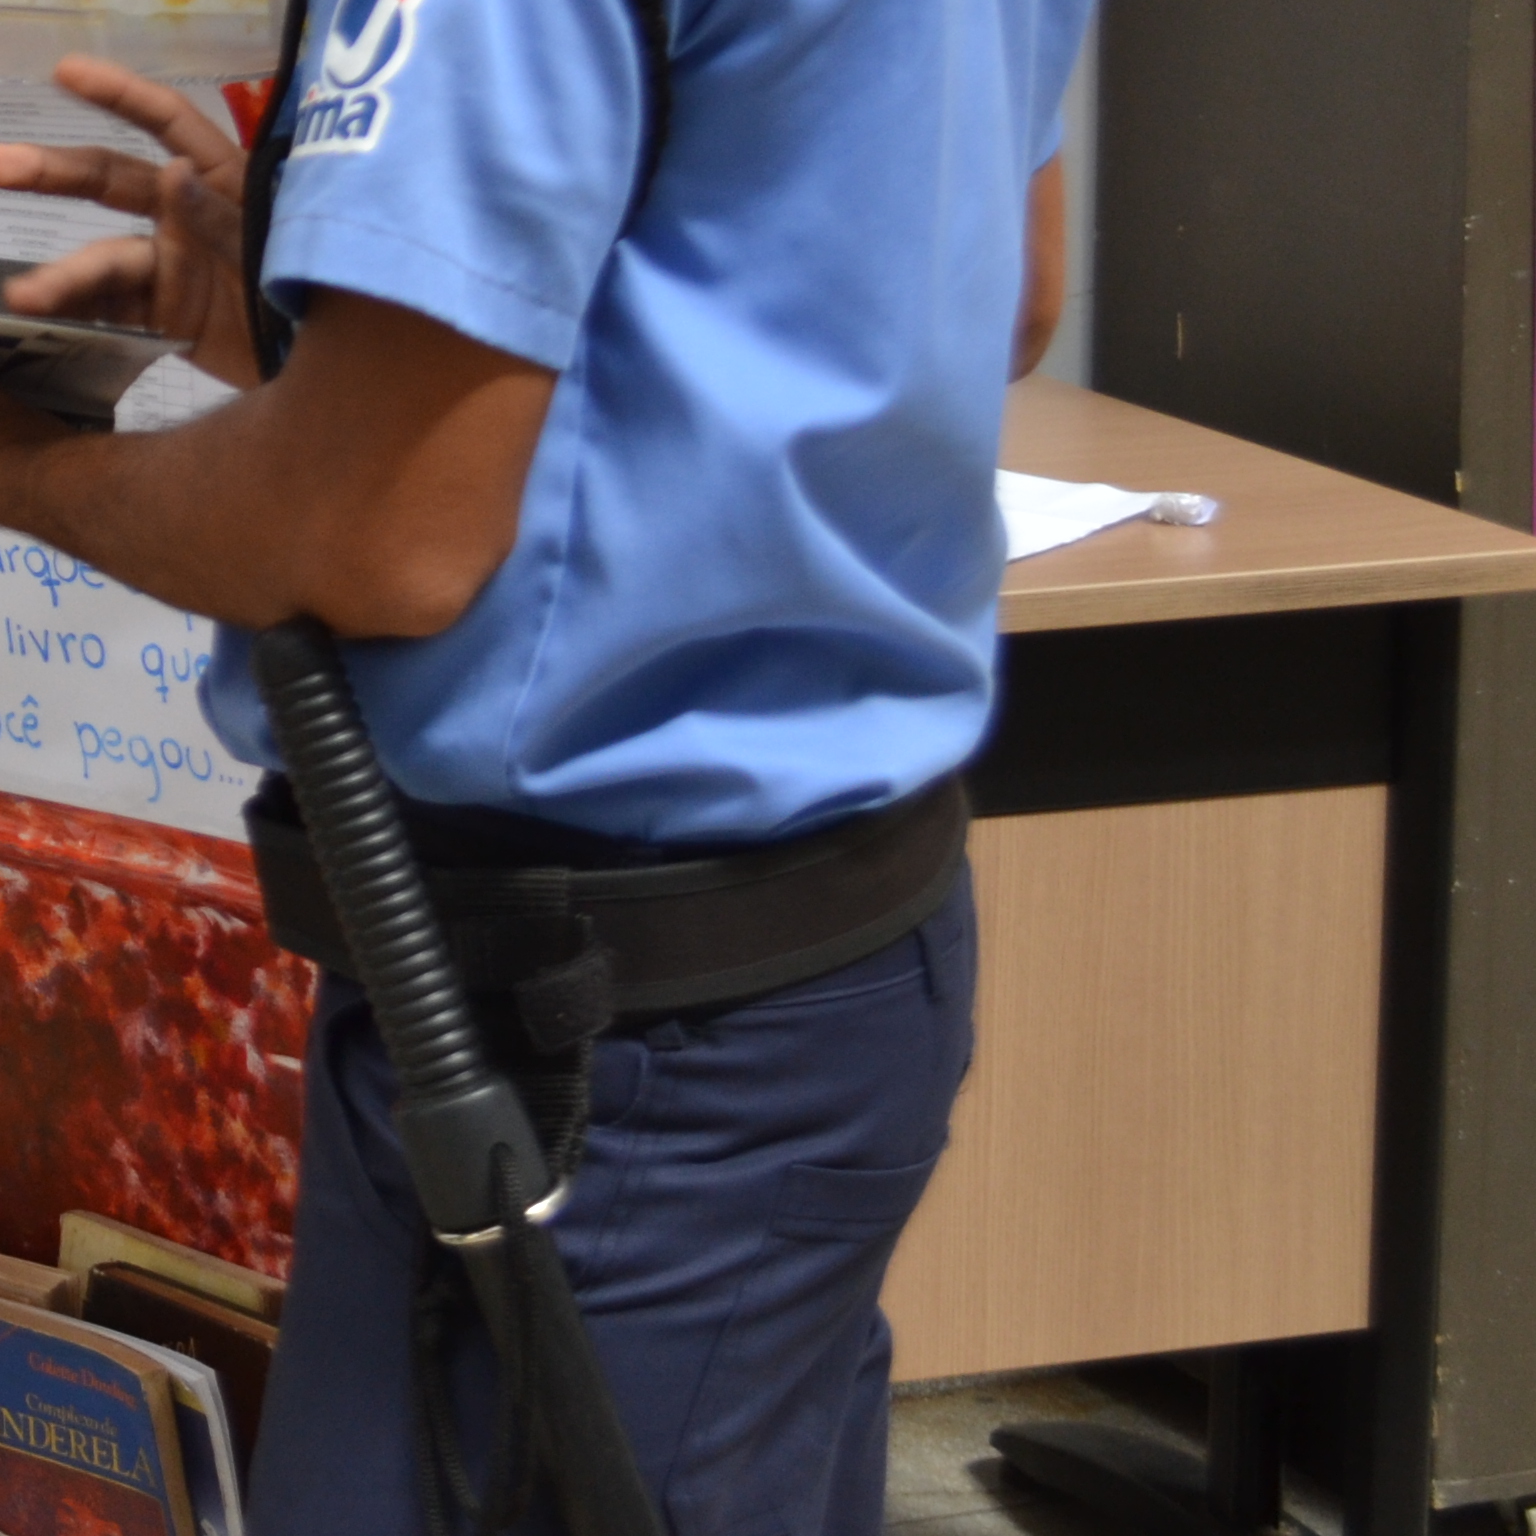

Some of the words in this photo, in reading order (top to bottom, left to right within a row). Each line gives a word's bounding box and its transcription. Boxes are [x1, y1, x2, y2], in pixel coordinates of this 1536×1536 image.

[5, 617, 106, 670] livro
[141, 642, 211, 704] que
[97, 1415, 118, 1437] de
